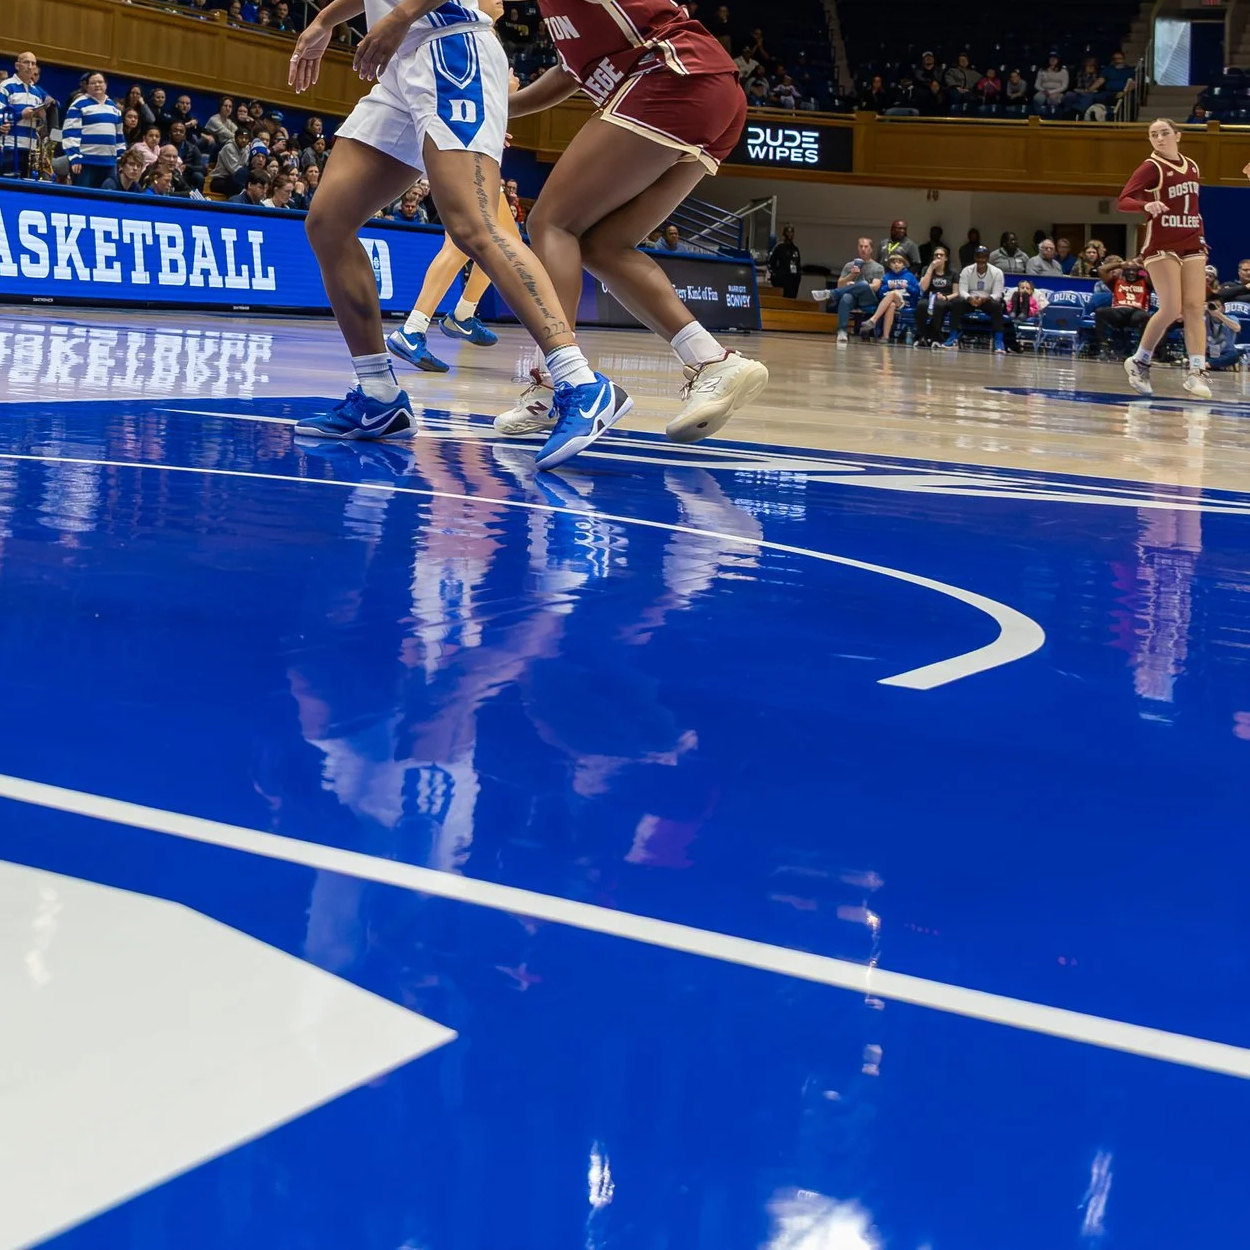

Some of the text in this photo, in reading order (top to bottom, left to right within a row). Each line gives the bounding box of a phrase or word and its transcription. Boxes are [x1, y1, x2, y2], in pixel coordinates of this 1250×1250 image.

[747, 127, 820, 149] DUDE
[747, 145, 819, 163] WIPES
[1183, 194, 1190, 215] 1
[1161, 214, 1200, 228] COLLEGE
[726, 293, 751, 308] BONVOY
[1053, 291, 1078, 304] DUKE
[1224, 301, 1250, 315] DUKE
[543, 320, 568, 341] 222
